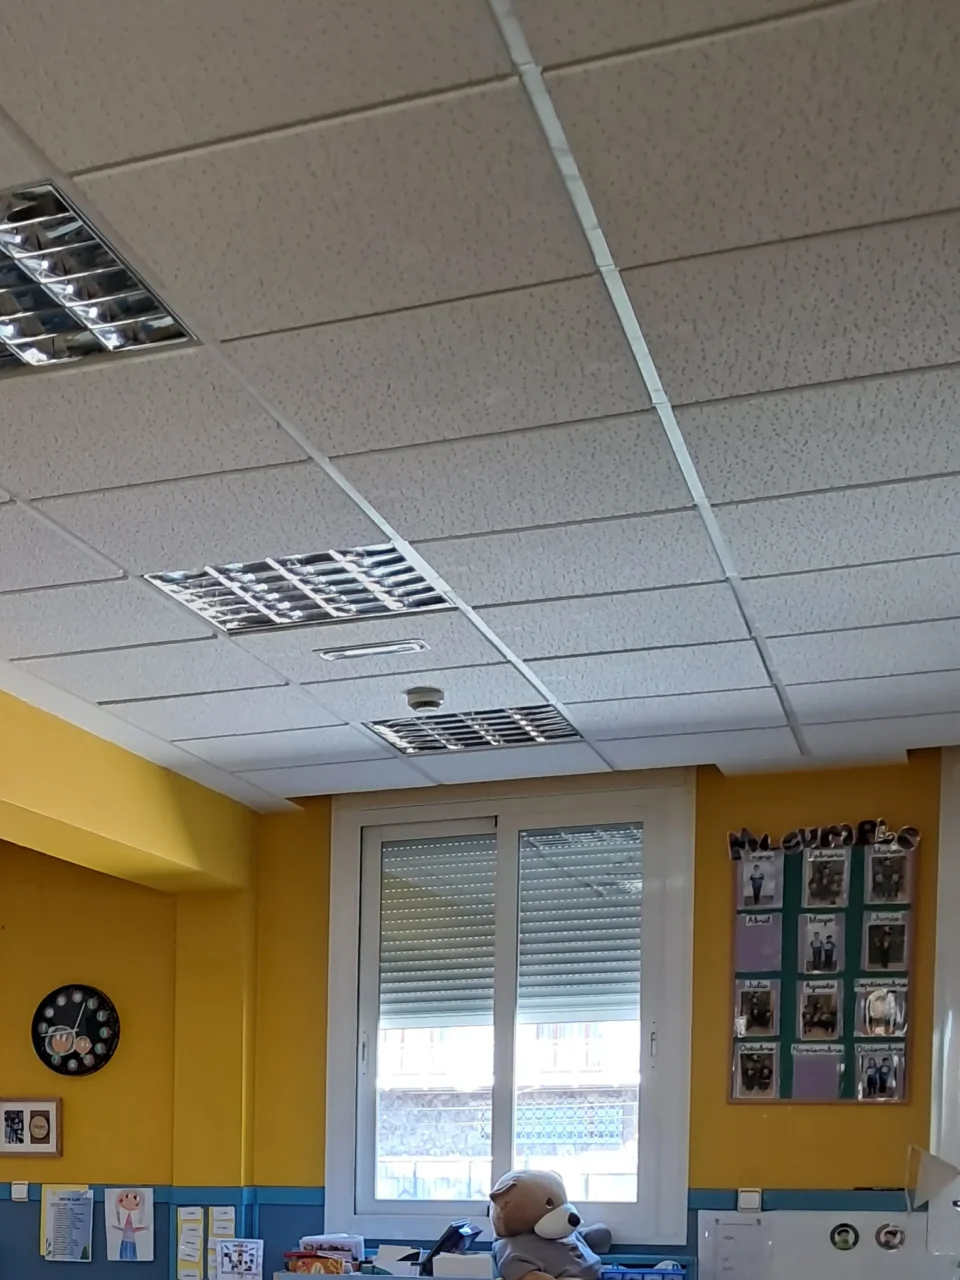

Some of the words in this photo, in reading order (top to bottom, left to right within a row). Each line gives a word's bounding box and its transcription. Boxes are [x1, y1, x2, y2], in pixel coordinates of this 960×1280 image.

[808, 851, 845, 860] Febrero
[747, 916, 771, 924] Abril
[808, 916, 834, 926] Mayo
[871, 914, 901, 922] Junio
[746, 981, 769, 990] Julio
[805, 982, 835, 991] Agosto
[855, 979, 908, 990] Septiembre
[740, 1043, 775, 1052] Octubre
[792, 1045, 844, 1054] Noviembre
[856, 1044, 904, 1053] Diciembre
